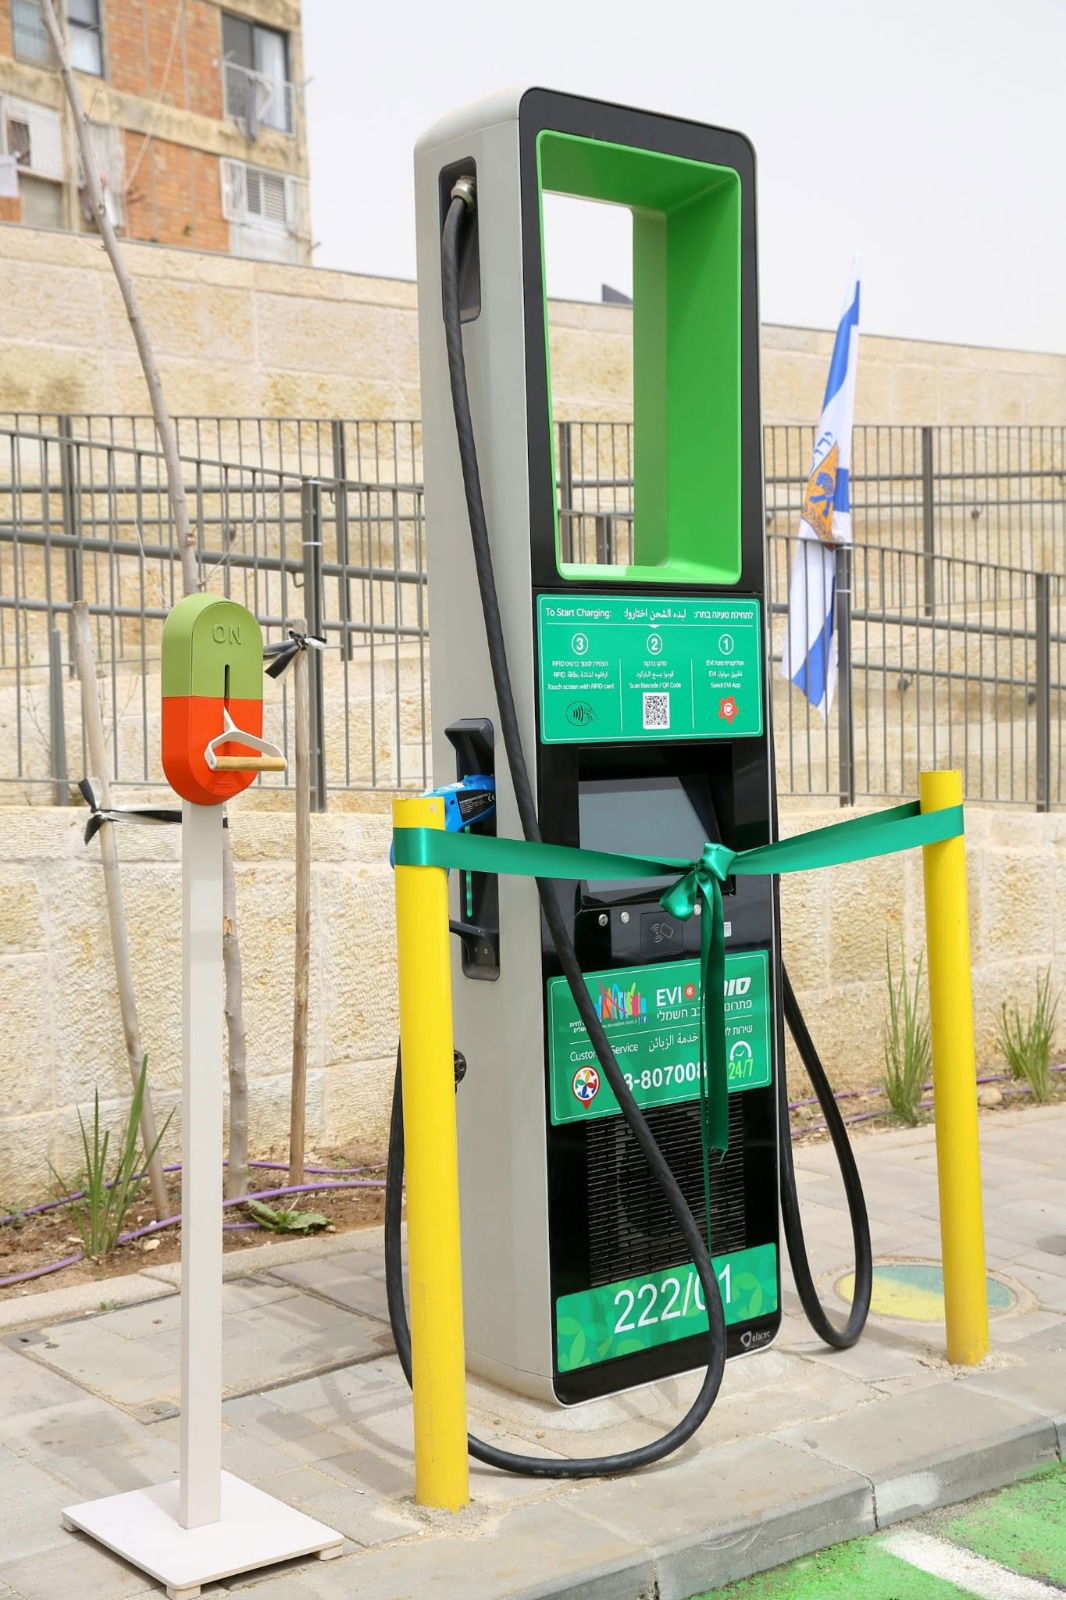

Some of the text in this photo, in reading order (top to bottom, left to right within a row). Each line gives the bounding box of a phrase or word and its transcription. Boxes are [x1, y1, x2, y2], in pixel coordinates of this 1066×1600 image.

[546, 608, 612, 620] To Start Charging:
[212, 623, 241, 645] ON
[656, 986, 682, 1006] EVI
[656, 1008, 688, 1021] חשמלי
[733, 1024, 753, 1035] שירות
[677, 1032, 699, 1044] خدمة
[610, 1042, 639, 1055] Service
[728, 1058, 753, 1080] 24/7
[624, 1060, 708, 1092] 3-807008
